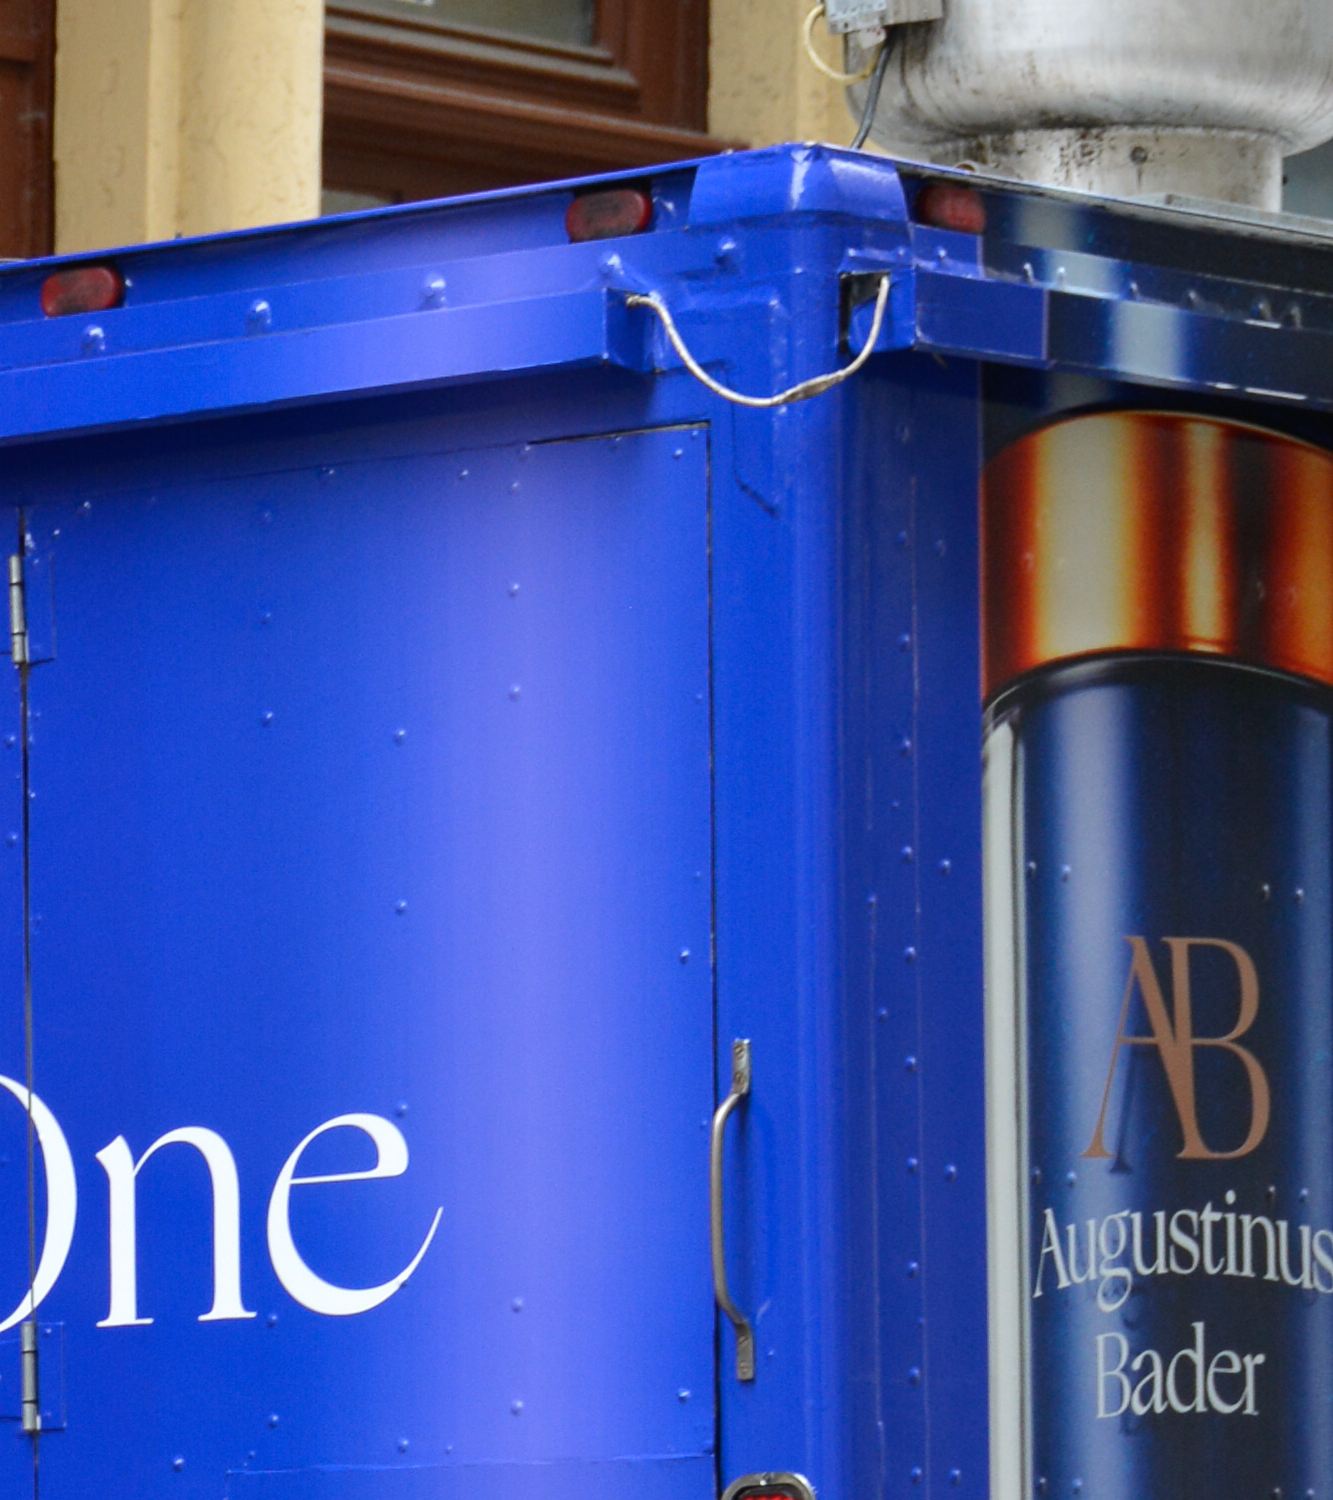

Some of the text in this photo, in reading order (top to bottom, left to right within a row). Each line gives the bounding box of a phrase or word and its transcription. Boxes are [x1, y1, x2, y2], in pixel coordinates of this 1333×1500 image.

[1079, 934, 1272, 1161] AB
[1033, 1190, 1333, 1313] Augustinus
[1095, 1321, 1266, 1422] Bader
